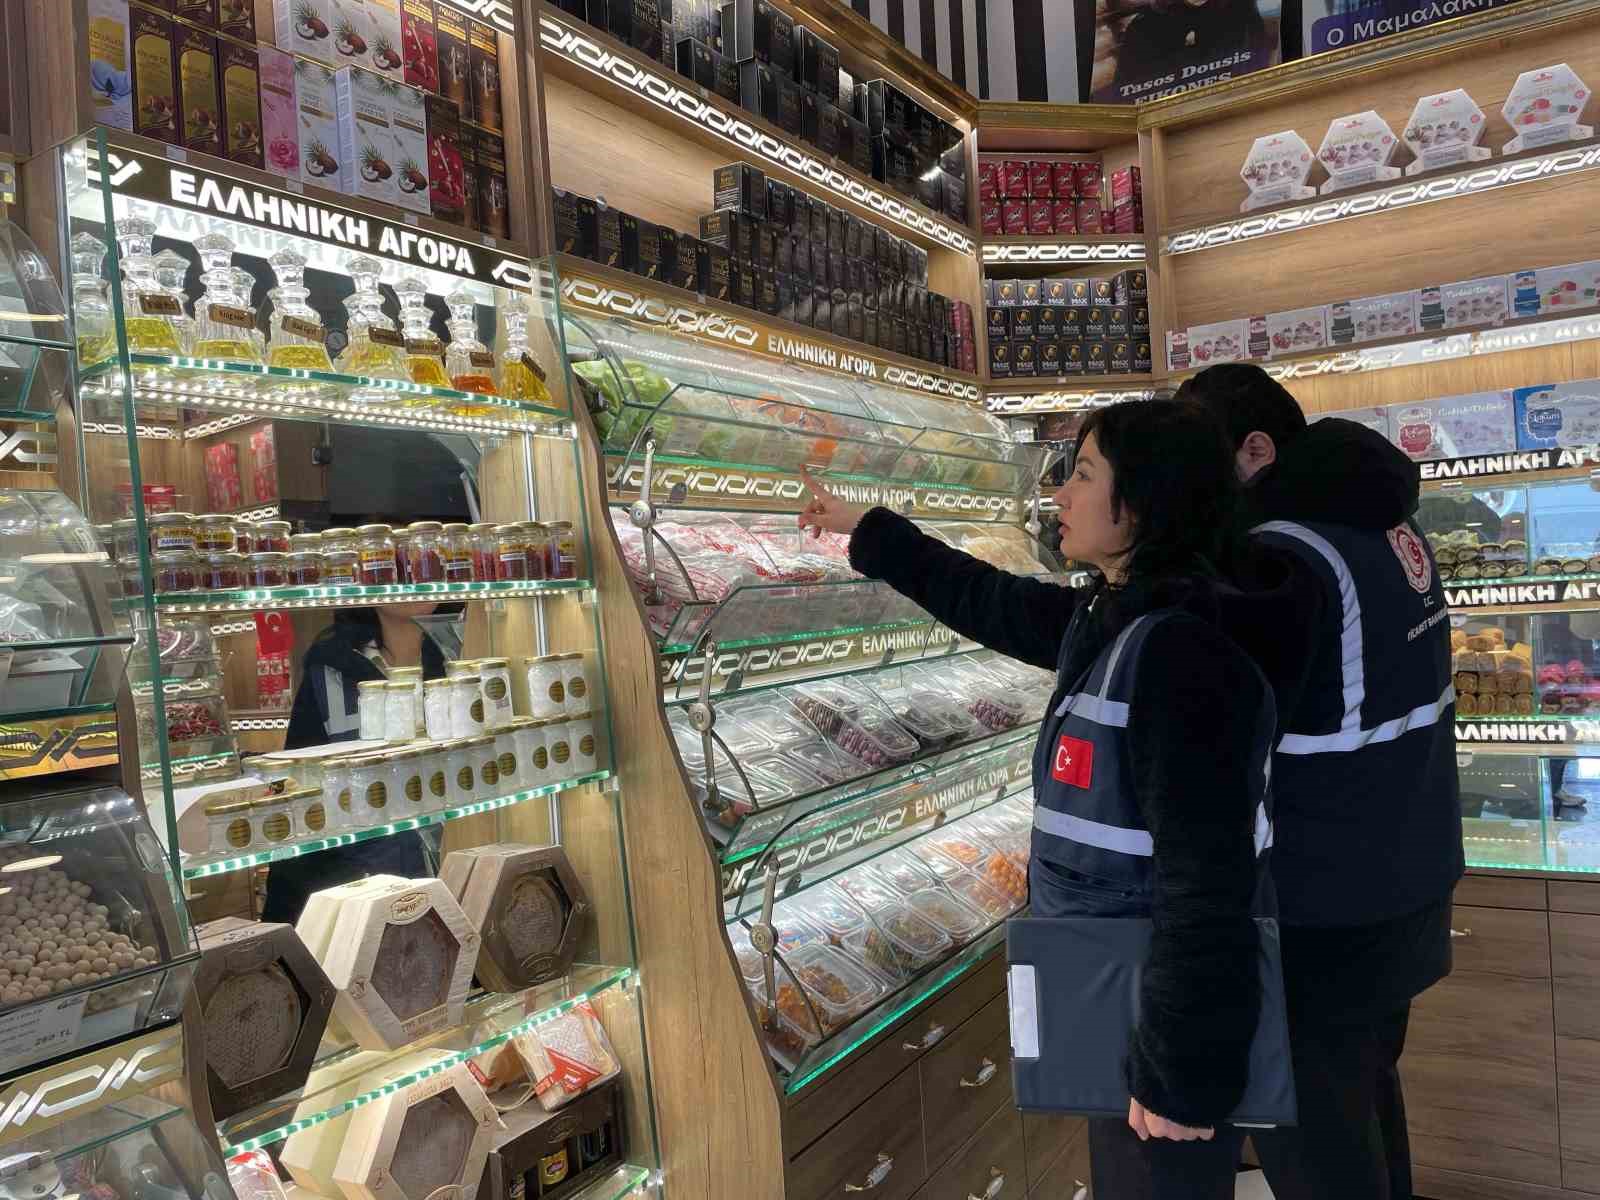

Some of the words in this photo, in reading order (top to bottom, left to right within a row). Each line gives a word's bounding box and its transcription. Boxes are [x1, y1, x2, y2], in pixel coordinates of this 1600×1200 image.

[1353, 0, 1509, 41] Μαμαλάκη
[1120, 73, 1175, 97] Tasos
[1181, 52, 1251, 79] Dousis
[170, 169, 369, 248] ΕΛΛΗΝΙΚΗ
[378, 226, 475, 275] ΑΓΟΡΑ
[767, 335, 837, 367] ΕΛΛΗΝΙΚΗ
[839, 353, 877, 377] ΑΓΟΡΑ
[1420, 451, 1549, 479] ΕΛΛΗΝΙΚΗ
[1443, 584, 1555, 606] ΛΛΗΝΙΚΗ
[862, 629, 926, 654] ΕΛΛΗΝΙΚΗ
[1455, 723, 1566, 741] ΛΛΗΝΙΚΗ
[915, 778, 975, 818] ΕΛΛΗΝΙΚΗ
